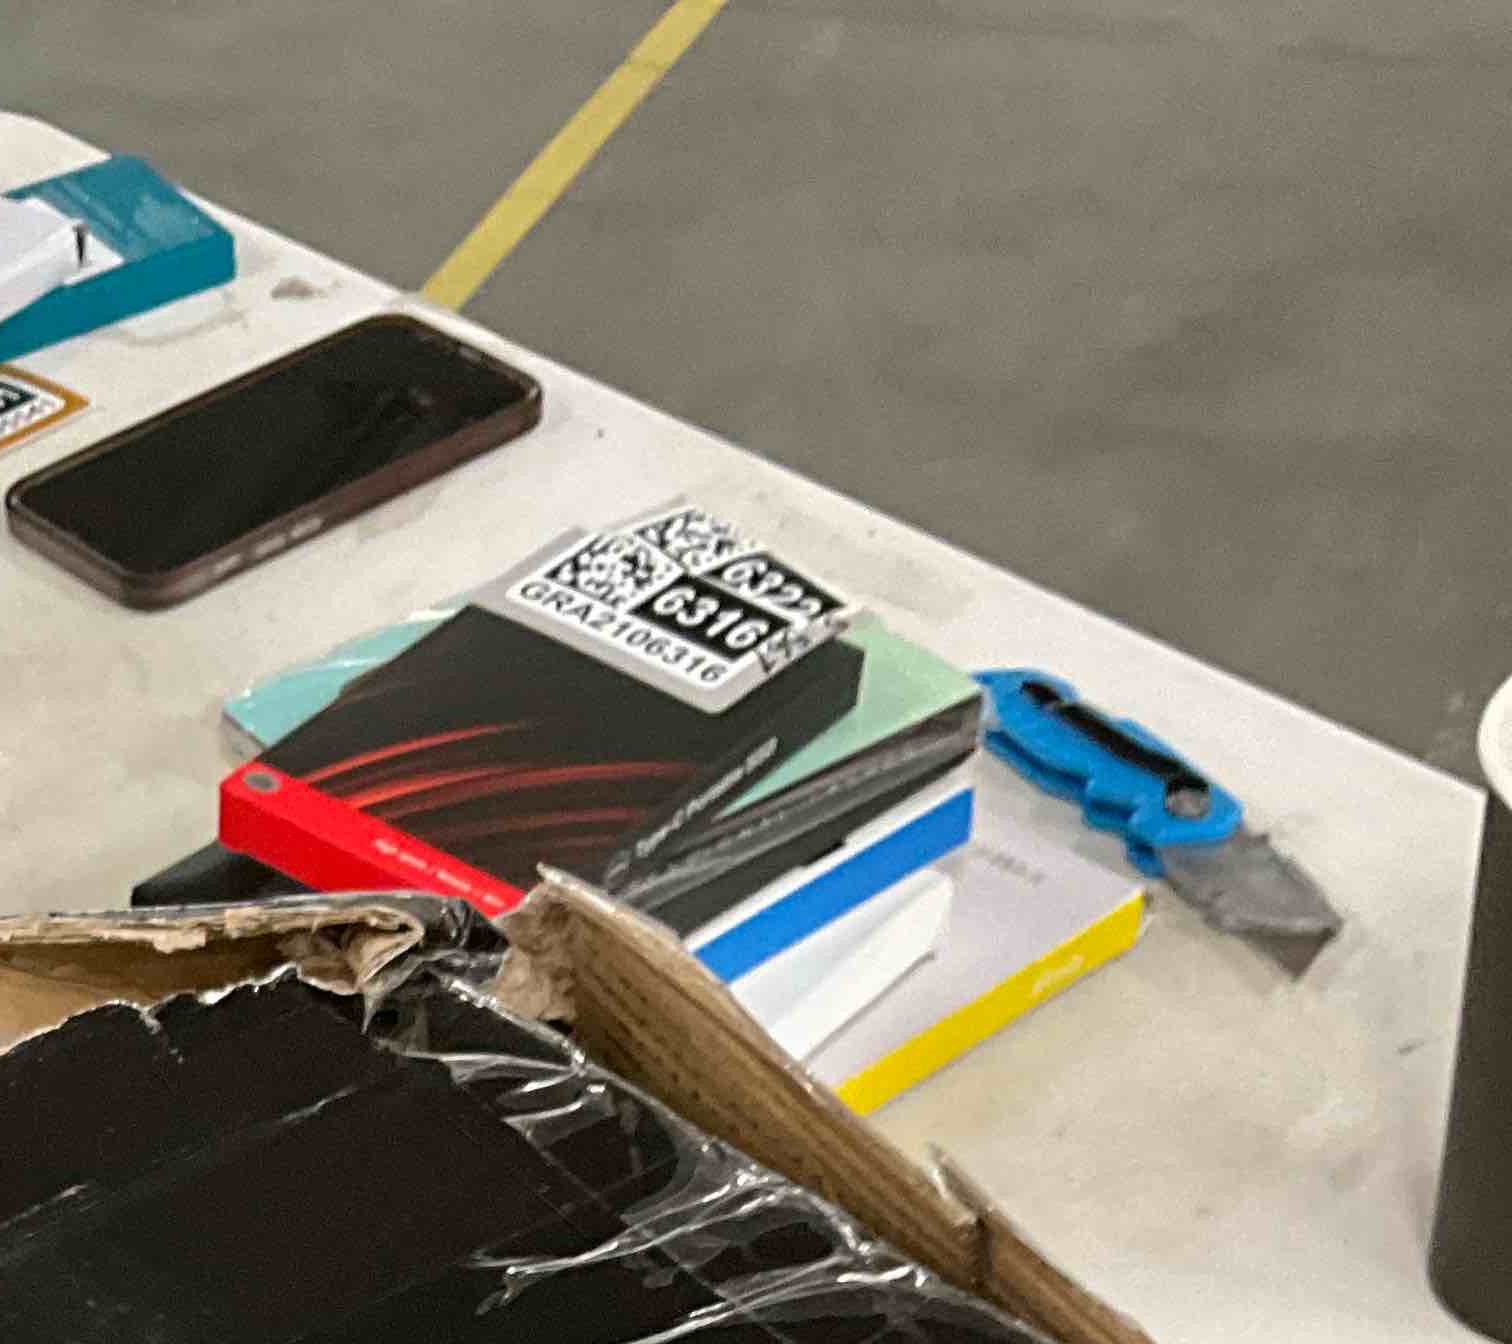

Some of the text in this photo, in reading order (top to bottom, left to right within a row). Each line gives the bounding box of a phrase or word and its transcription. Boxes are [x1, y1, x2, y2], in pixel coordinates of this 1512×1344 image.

[652, 586, 770, 649] 6316
[722, 555, 824, 618] 6322
[520, 581, 728, 683] GRA2106316
